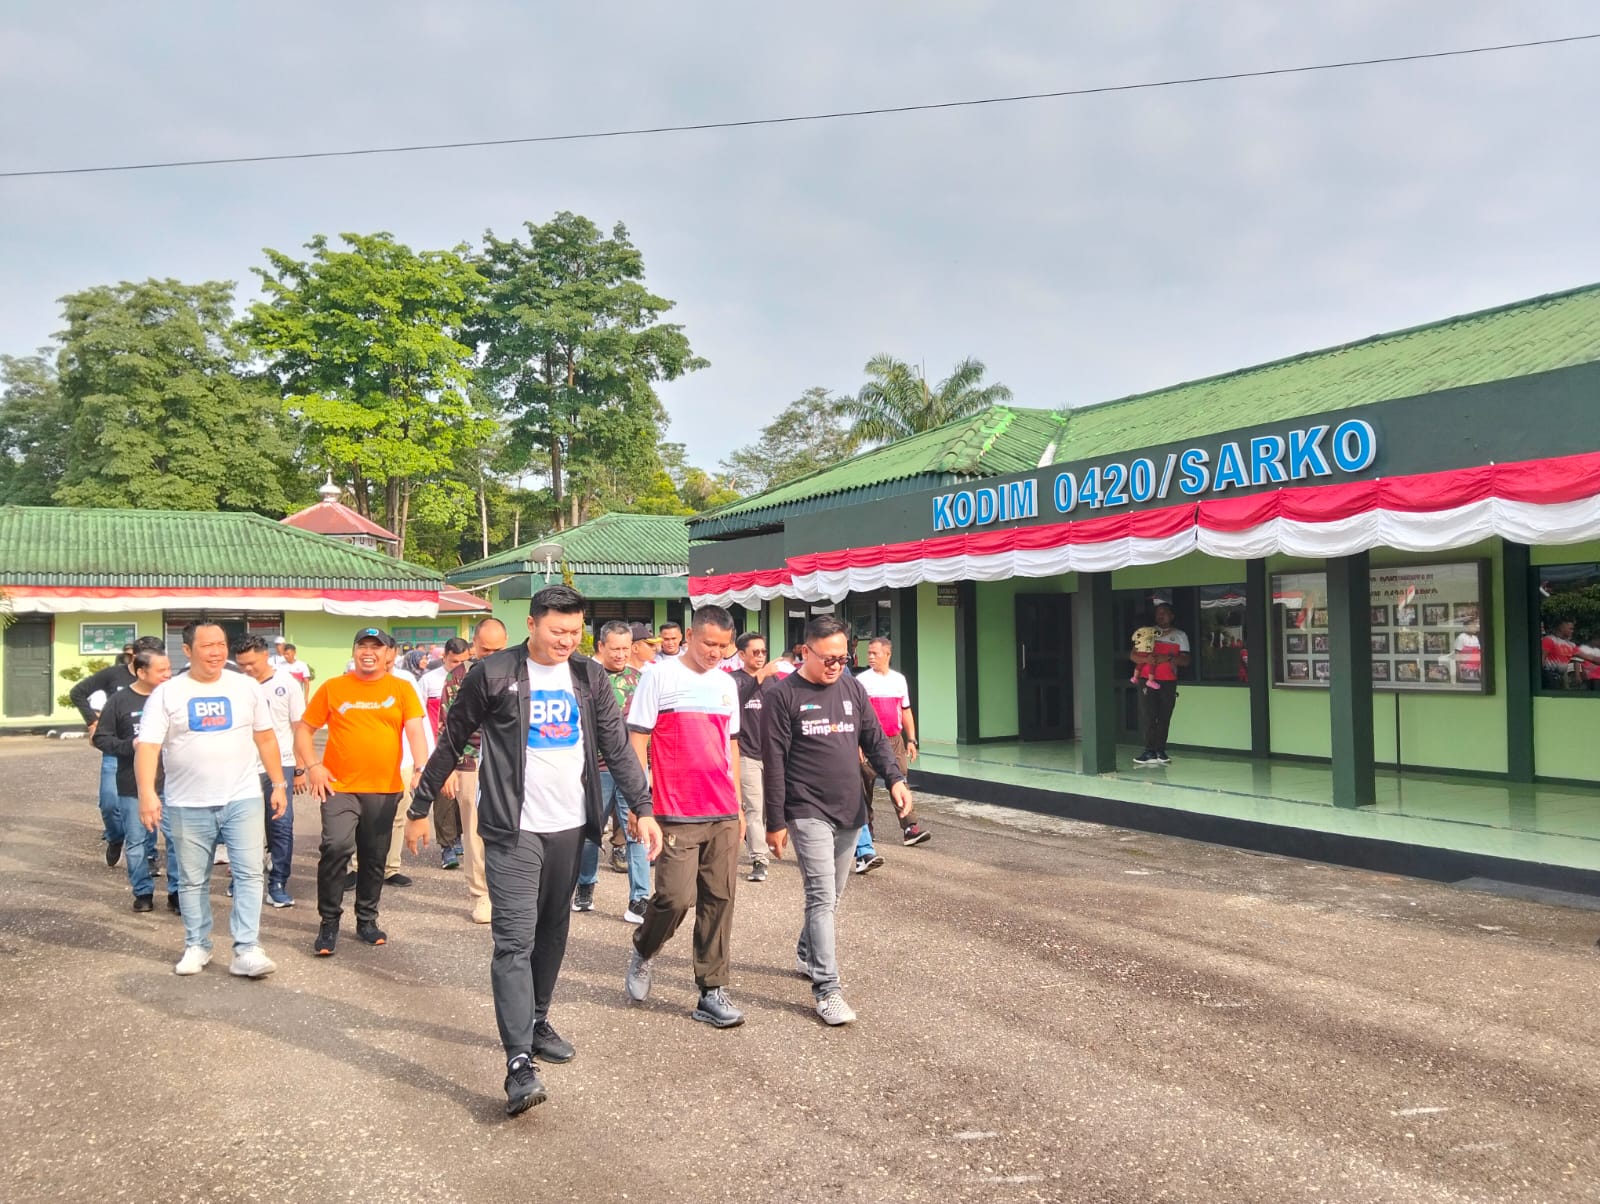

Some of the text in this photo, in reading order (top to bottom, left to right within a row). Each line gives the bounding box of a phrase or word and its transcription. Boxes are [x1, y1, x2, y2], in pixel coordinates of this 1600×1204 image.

[932, 418, 1378, 531] KODIM 0420/SARKO
[194, 701, 225, 717] BRI
[529, 699, 572, 724] BRI
[802, 721, 855, 736] Simpedes
